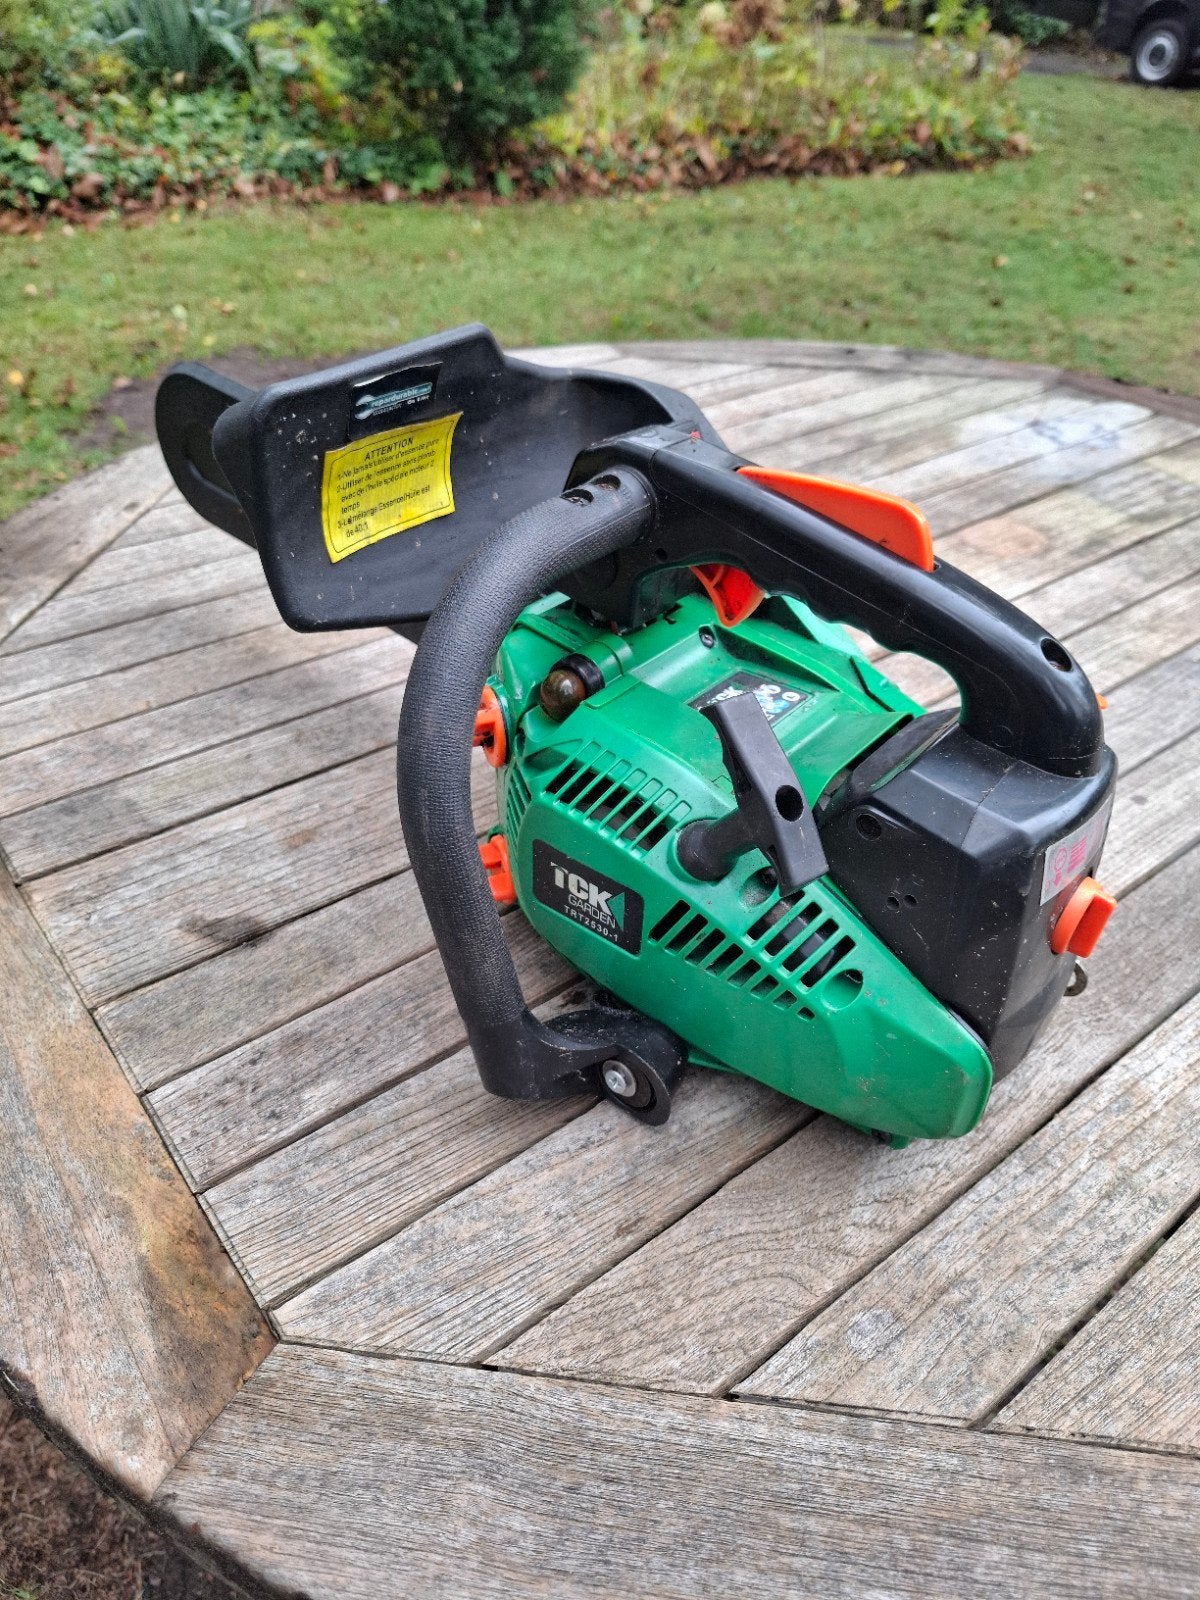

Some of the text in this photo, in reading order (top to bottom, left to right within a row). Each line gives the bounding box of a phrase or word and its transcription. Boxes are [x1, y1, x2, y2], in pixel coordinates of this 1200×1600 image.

[364, 436, 414, 461] ATTENTION
[341, 490, 356, 502] avec
[356, 487, 365, 496] de
[409, 462, 430, 475] moteur
[421, 484, 430, 494] est
[341, 501, 360, 514] temps
[346, 529, 354, 538] de
[550, 861, 613, 917] TCK
[563, 904, 619, 942] TRT2530-1
[568, 893, 616, 929] GARDEN
